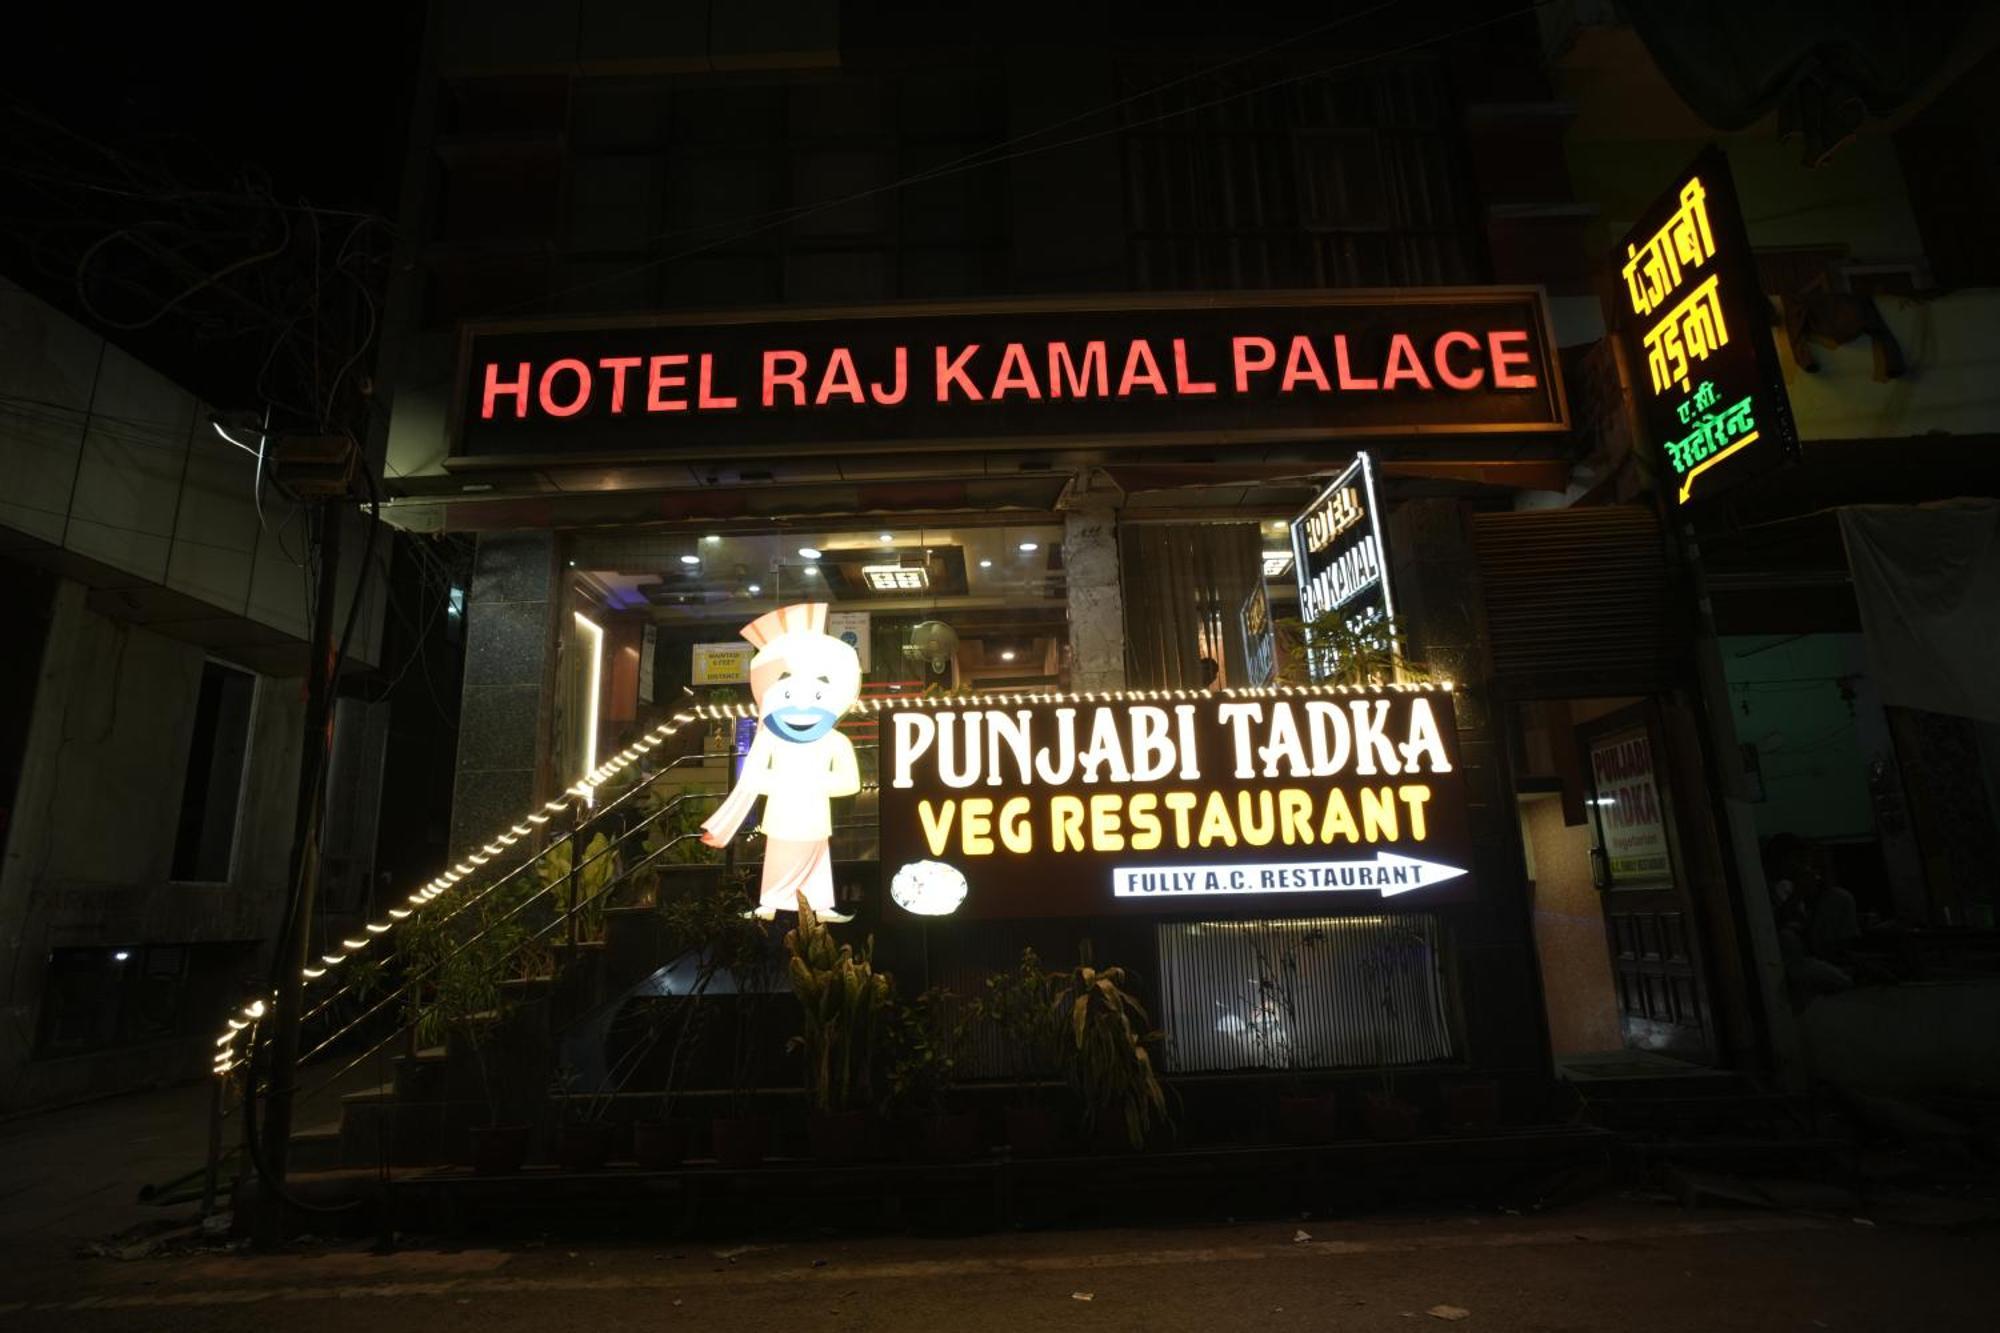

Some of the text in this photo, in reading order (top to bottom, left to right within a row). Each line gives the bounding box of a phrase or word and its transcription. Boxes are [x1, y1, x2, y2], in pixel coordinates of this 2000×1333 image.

[1622, 177, 1716, 316] पंजाबी
[481, 330, 1537, 419] HOTEL RAJ KAMAL PALACE
[1643, 274, 1729, 396] तड़का
[1306, 487, 1360, 553] HOTEL
[893, 697, 1453, 789] PUNJABI TADKA
[917, 784, 1432, 856] VEG RESTAURANT
[1127, 864, 1424, 892] FULLY A.C. RESTAURANT
